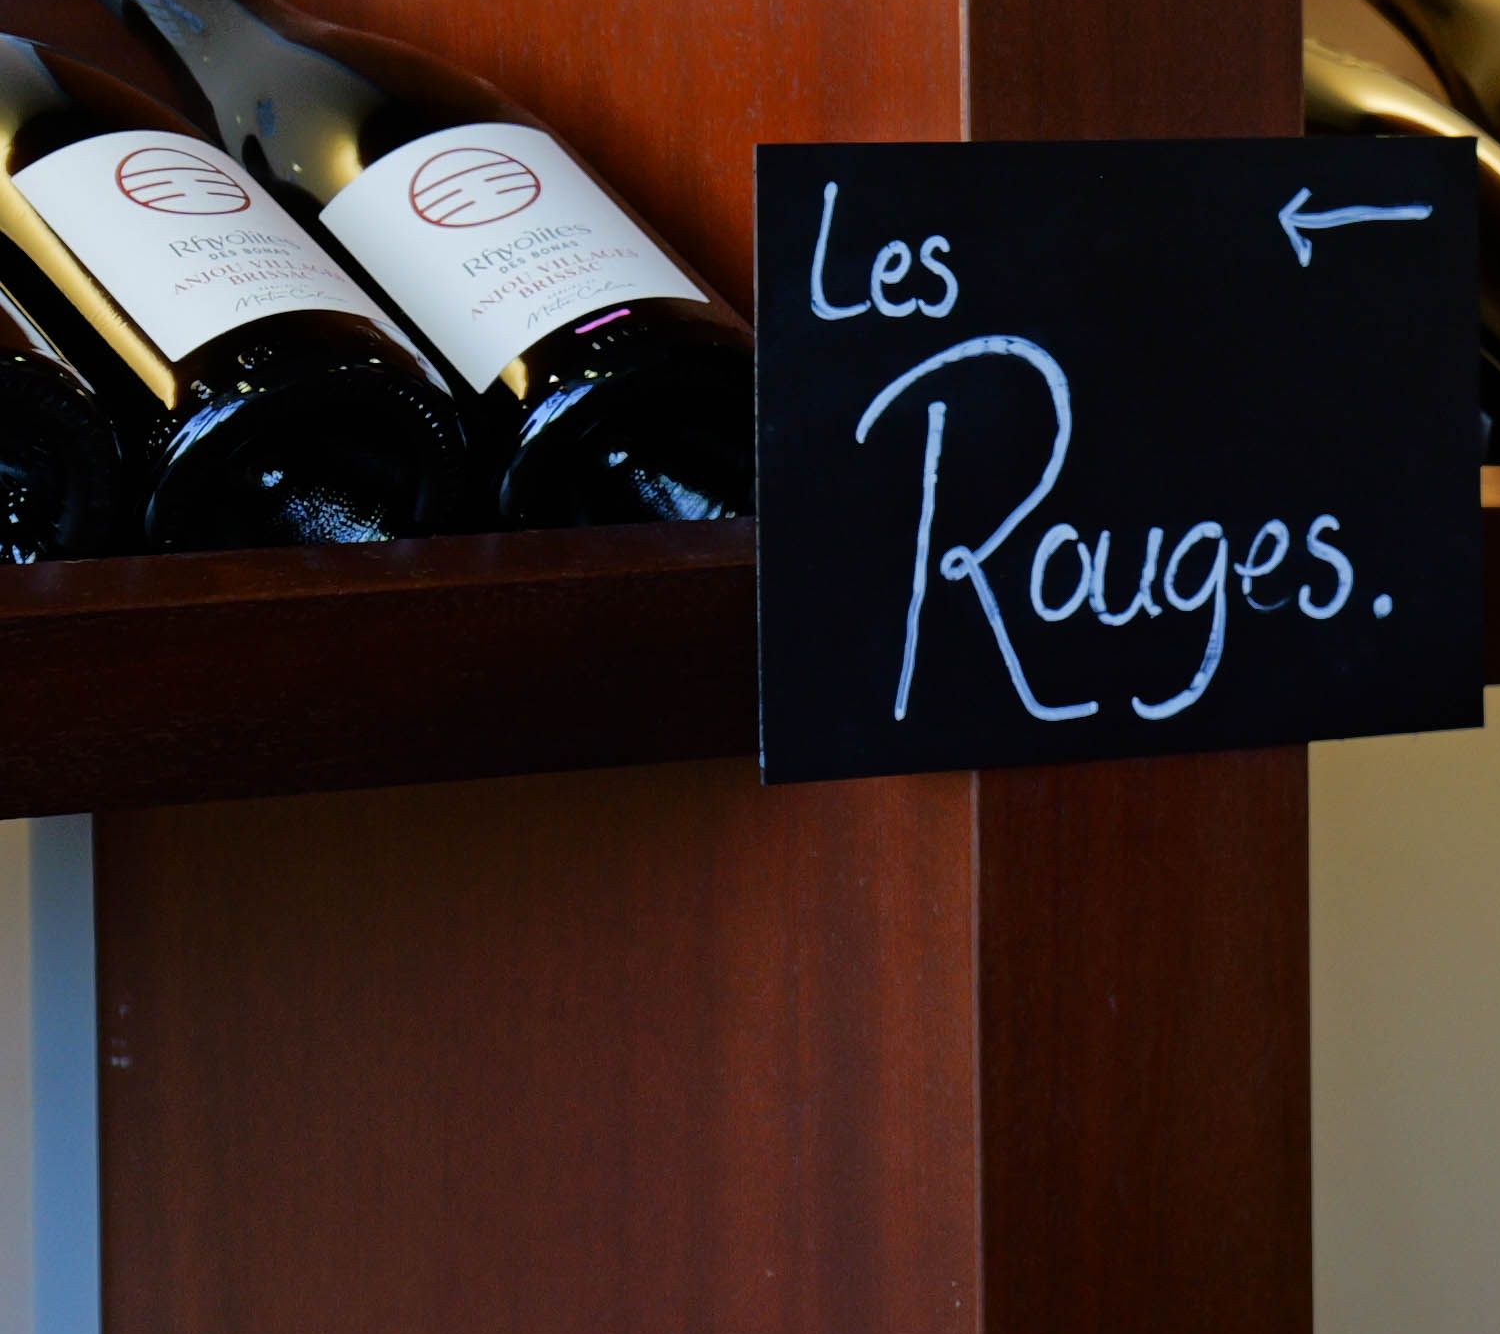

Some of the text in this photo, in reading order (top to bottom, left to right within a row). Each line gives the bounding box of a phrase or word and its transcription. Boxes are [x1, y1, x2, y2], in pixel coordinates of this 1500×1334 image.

[470, 272, 533, 323] ANJOU
[518, 261, 603, 300] BRISSAC
[810, 181, 959, 321] Les
[854, 335, 1394, 722] Rouges.
